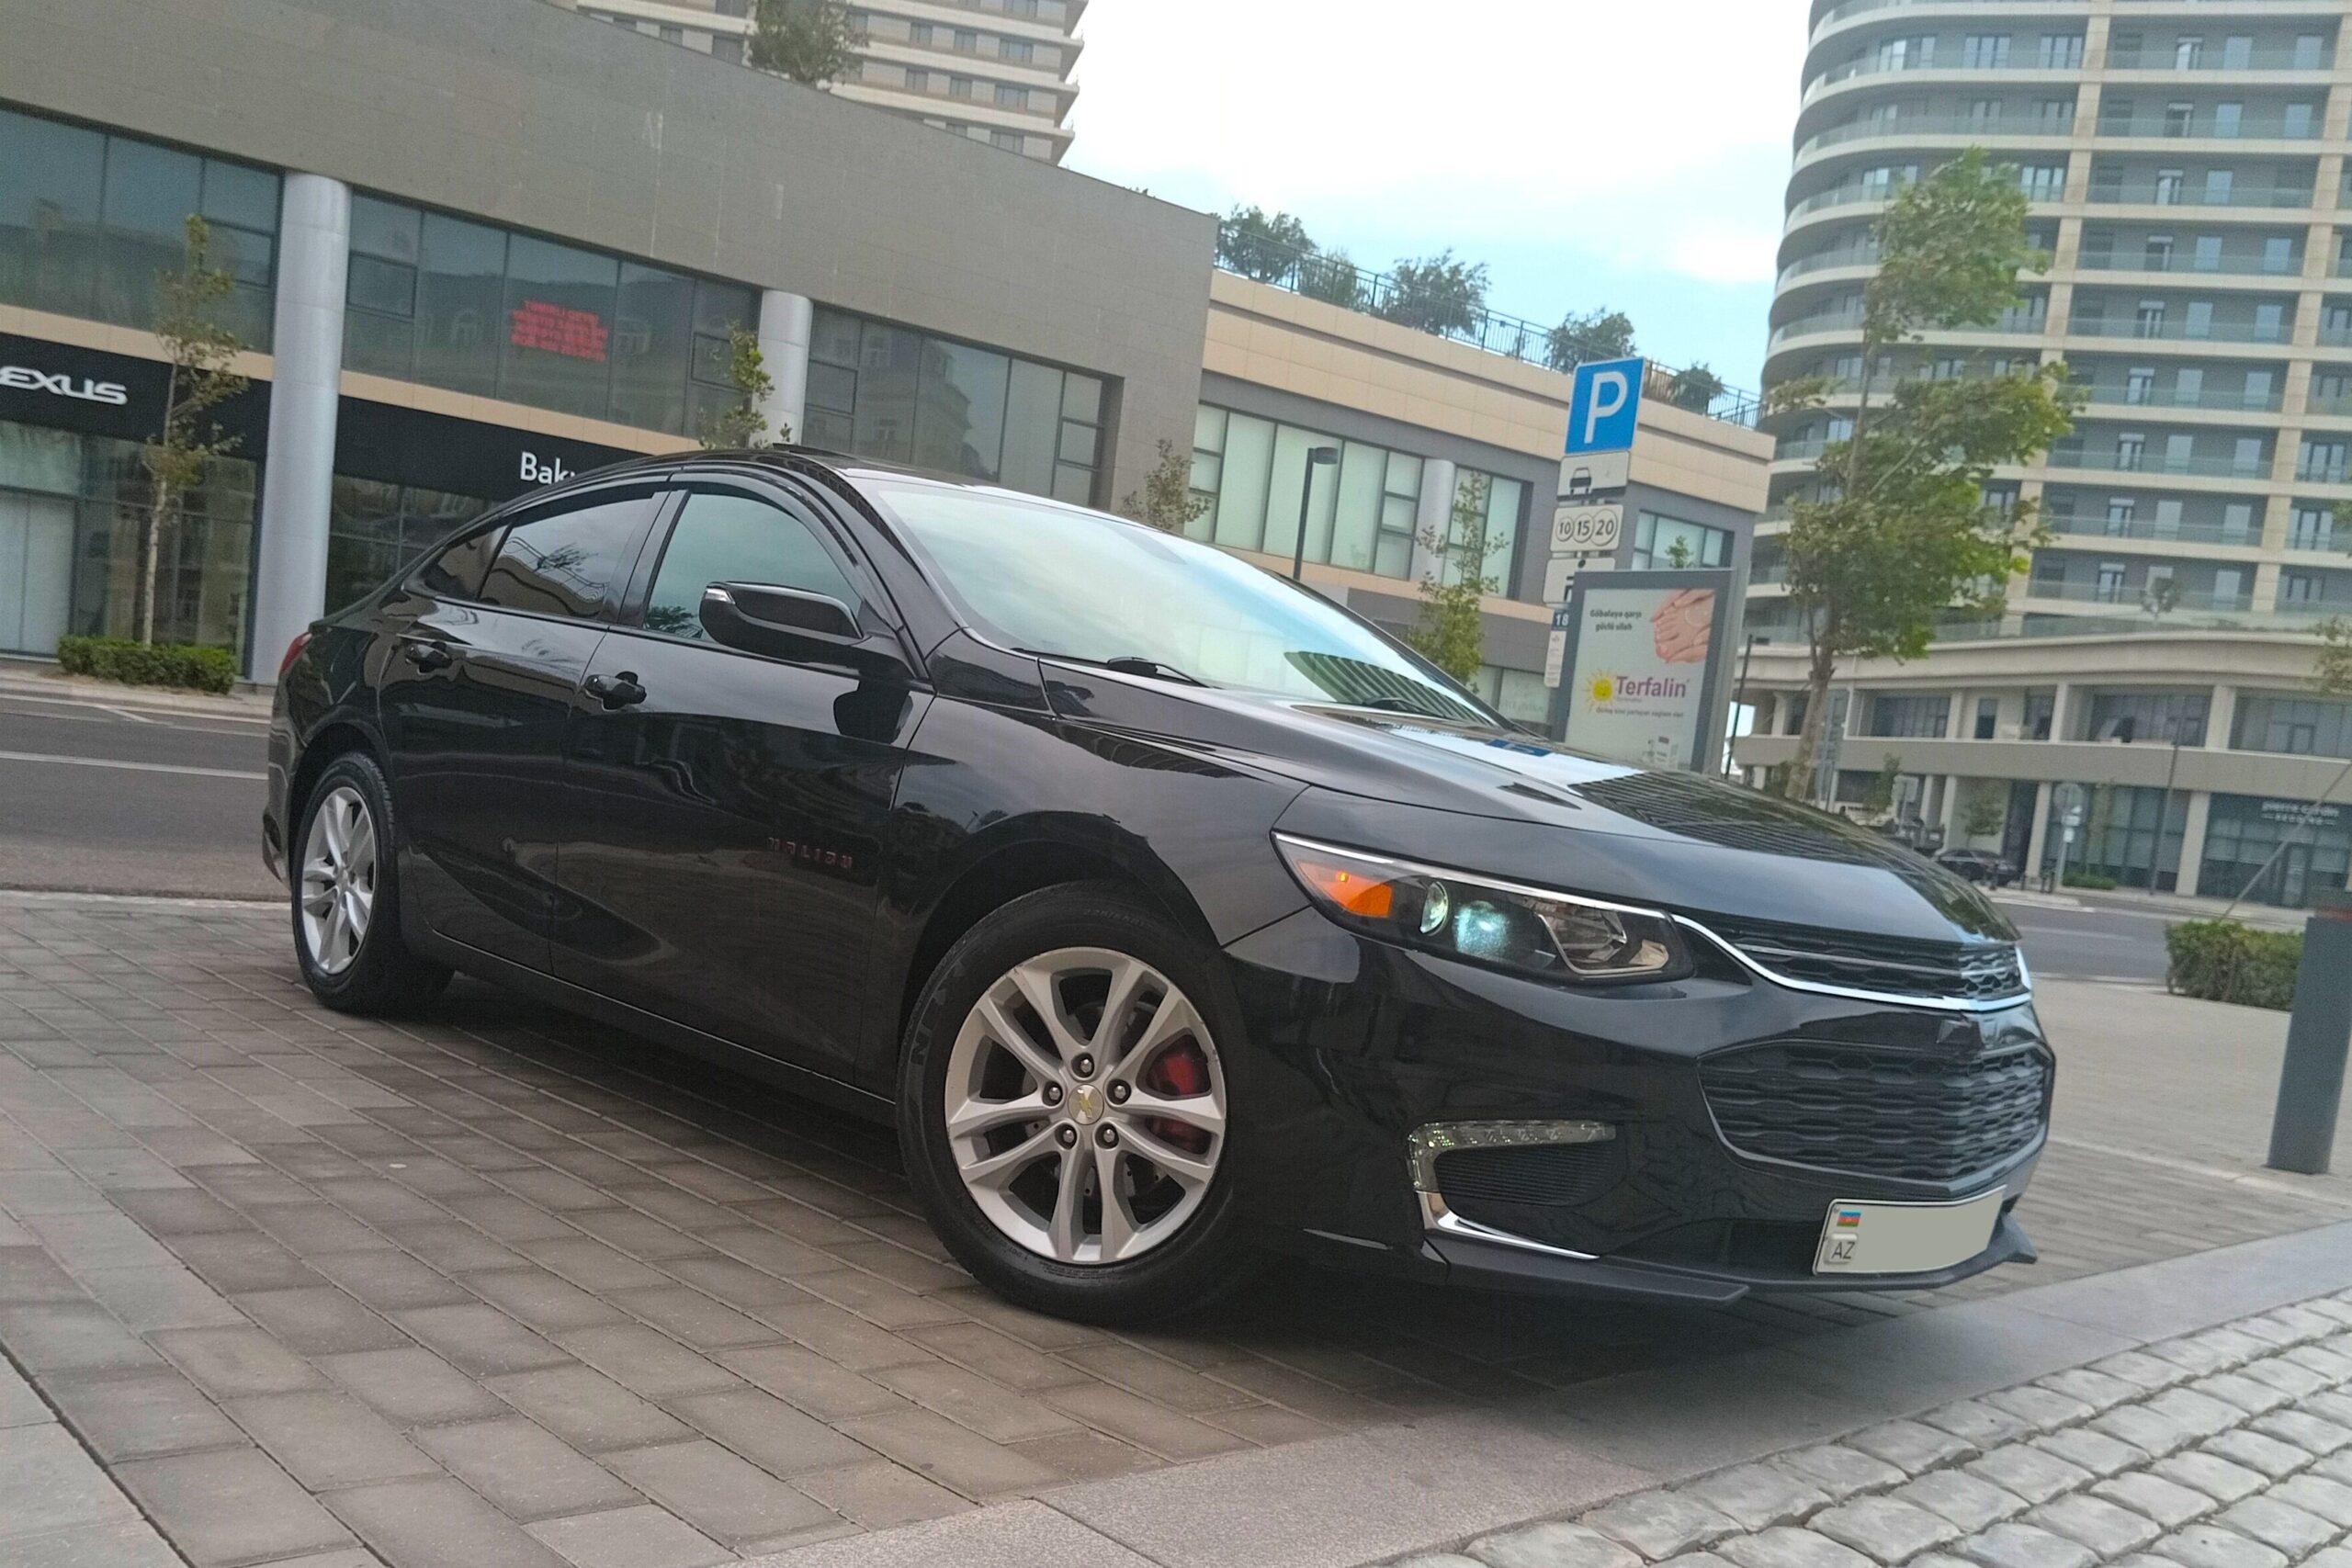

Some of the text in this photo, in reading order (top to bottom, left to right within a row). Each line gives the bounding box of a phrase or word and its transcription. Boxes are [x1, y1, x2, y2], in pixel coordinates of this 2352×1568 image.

[0, 366, 128, 405] EXUS
[1584, 371, 1628, 444] P
[517, 451, 575, 485] Bak
[1559, 519, 1614, 536] 10 15 20
[1555, 613, 1569, 626] 18
[1616, 676, 1687, 698] Terfalin
[1831, 1241, 1855, 1259] AZ
